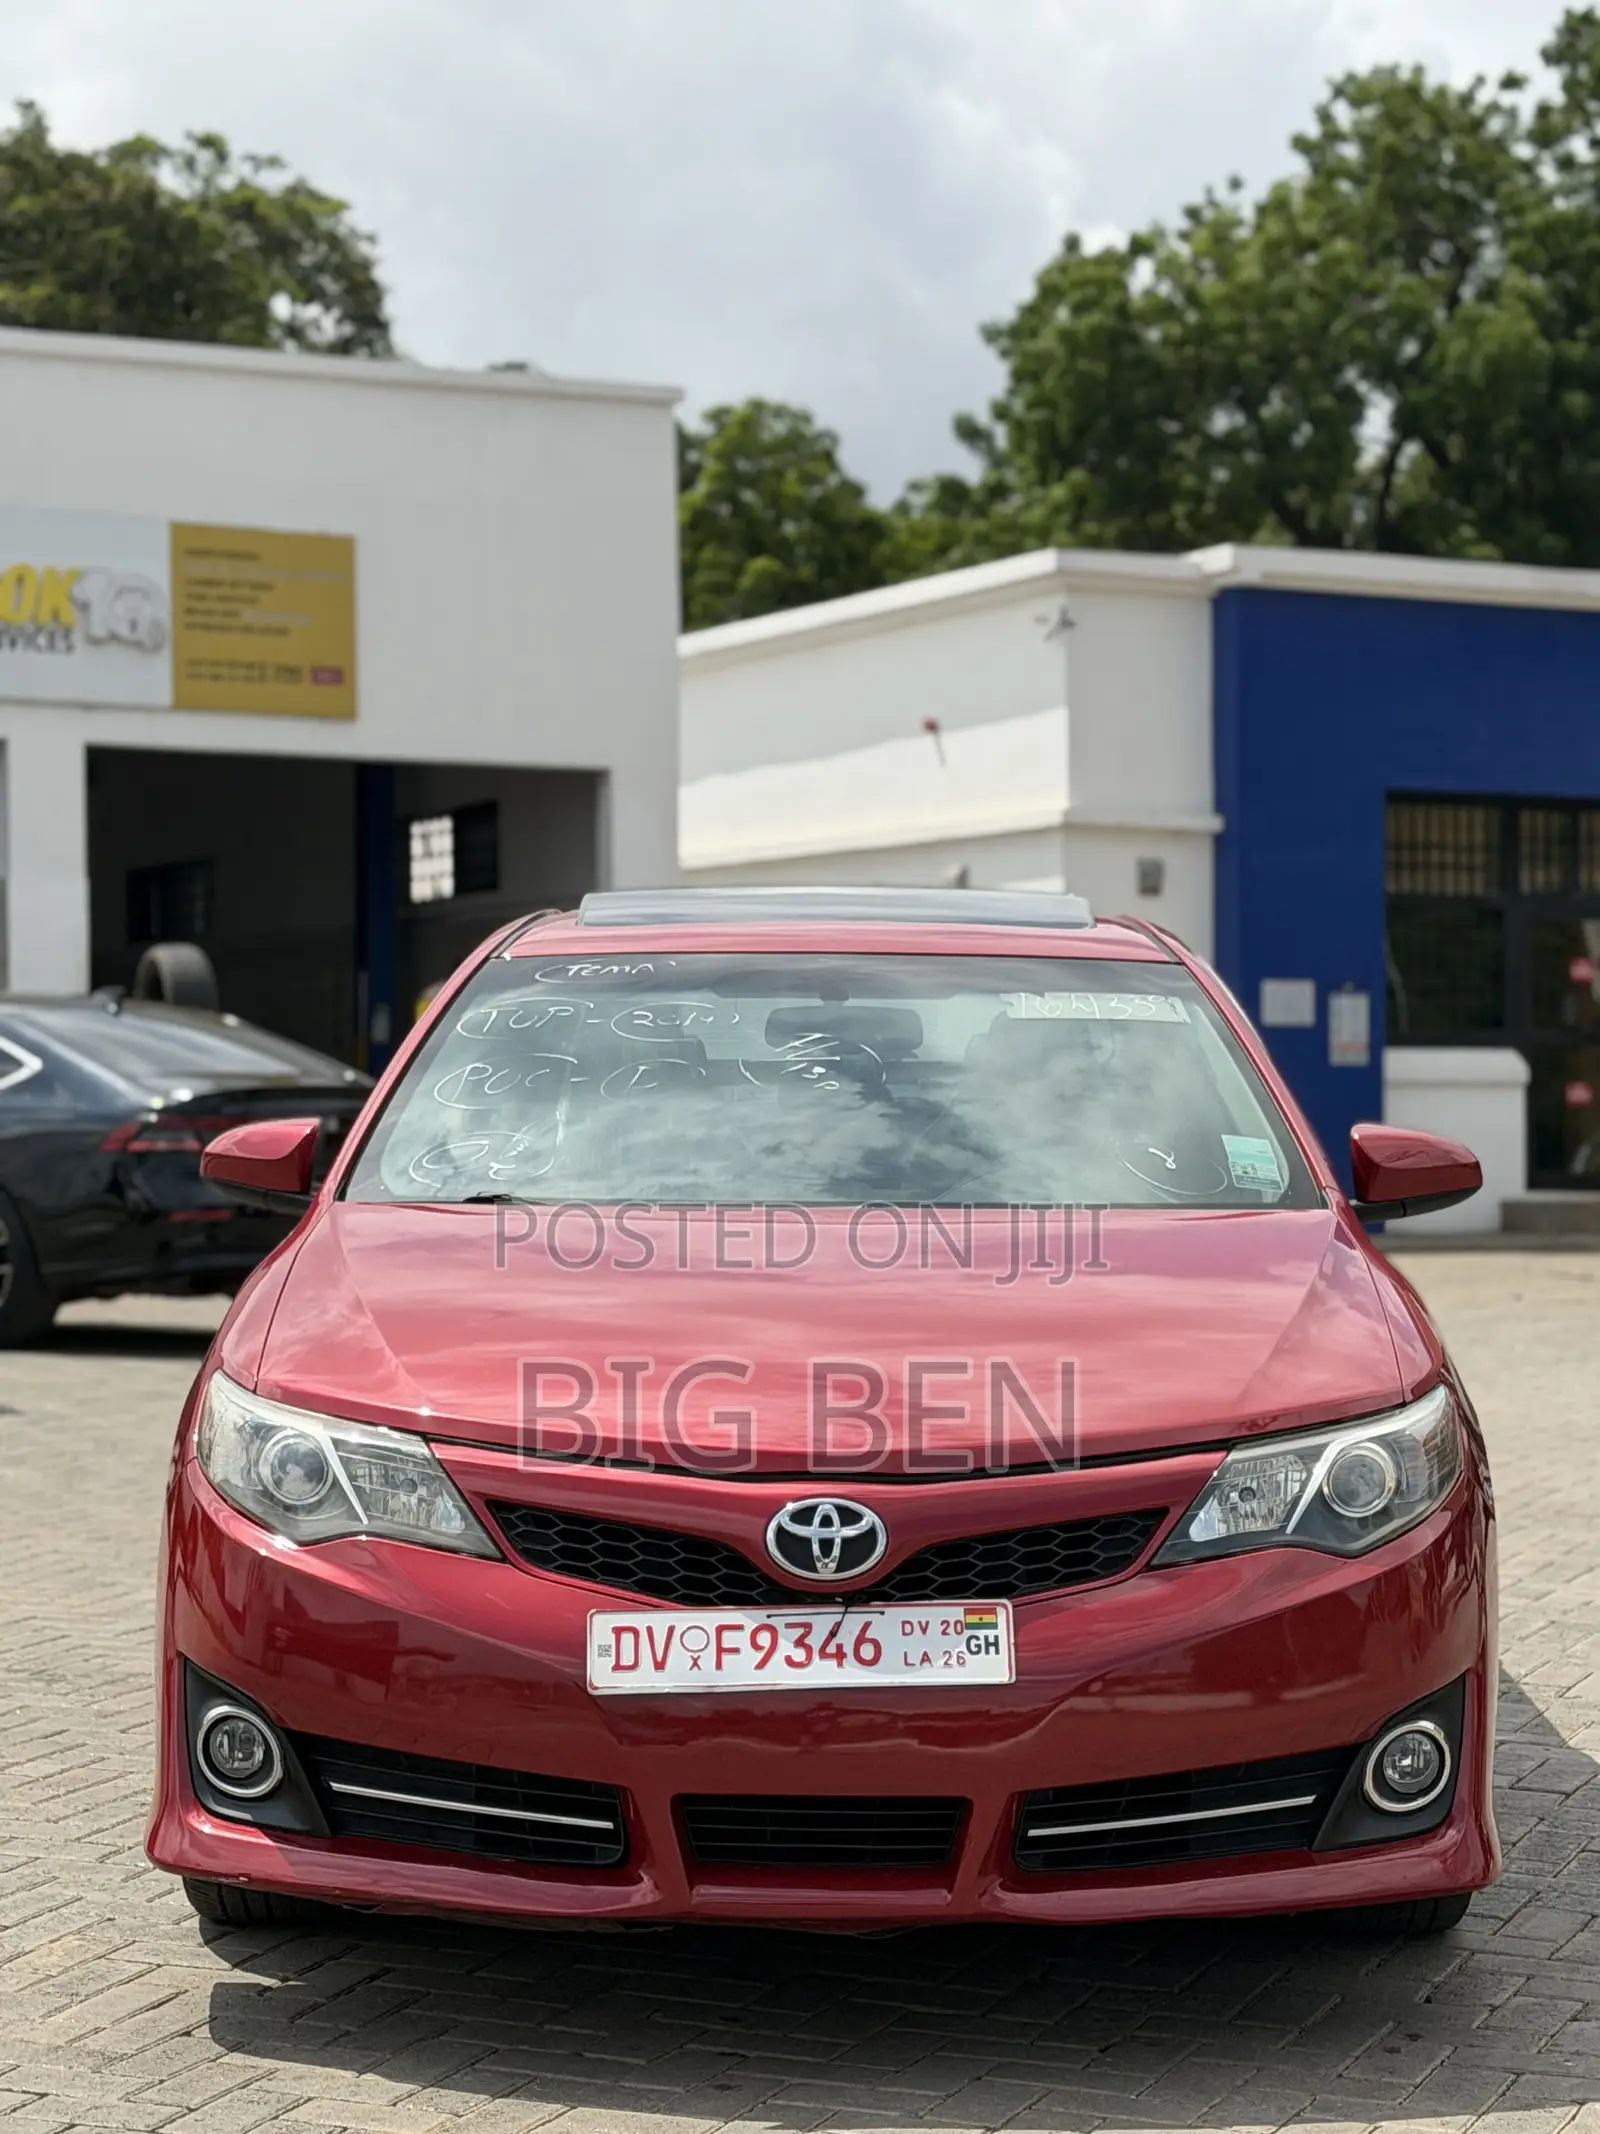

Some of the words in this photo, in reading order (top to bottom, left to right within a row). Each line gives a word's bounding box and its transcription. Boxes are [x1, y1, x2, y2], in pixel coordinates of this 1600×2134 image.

[566, 963, 656, 977] TEMA
[901, 1619, 930, 1637] DV
[940, 1619, 965, 1636] 20
[611, 1624, 676, 1673] DV
[714, 1620, 883, 1670] F9346
[966, 1634, 1000, 1656] GH
[903, 1650, 934, 1668] LA
[942, 1650, 967, 1667] 26
